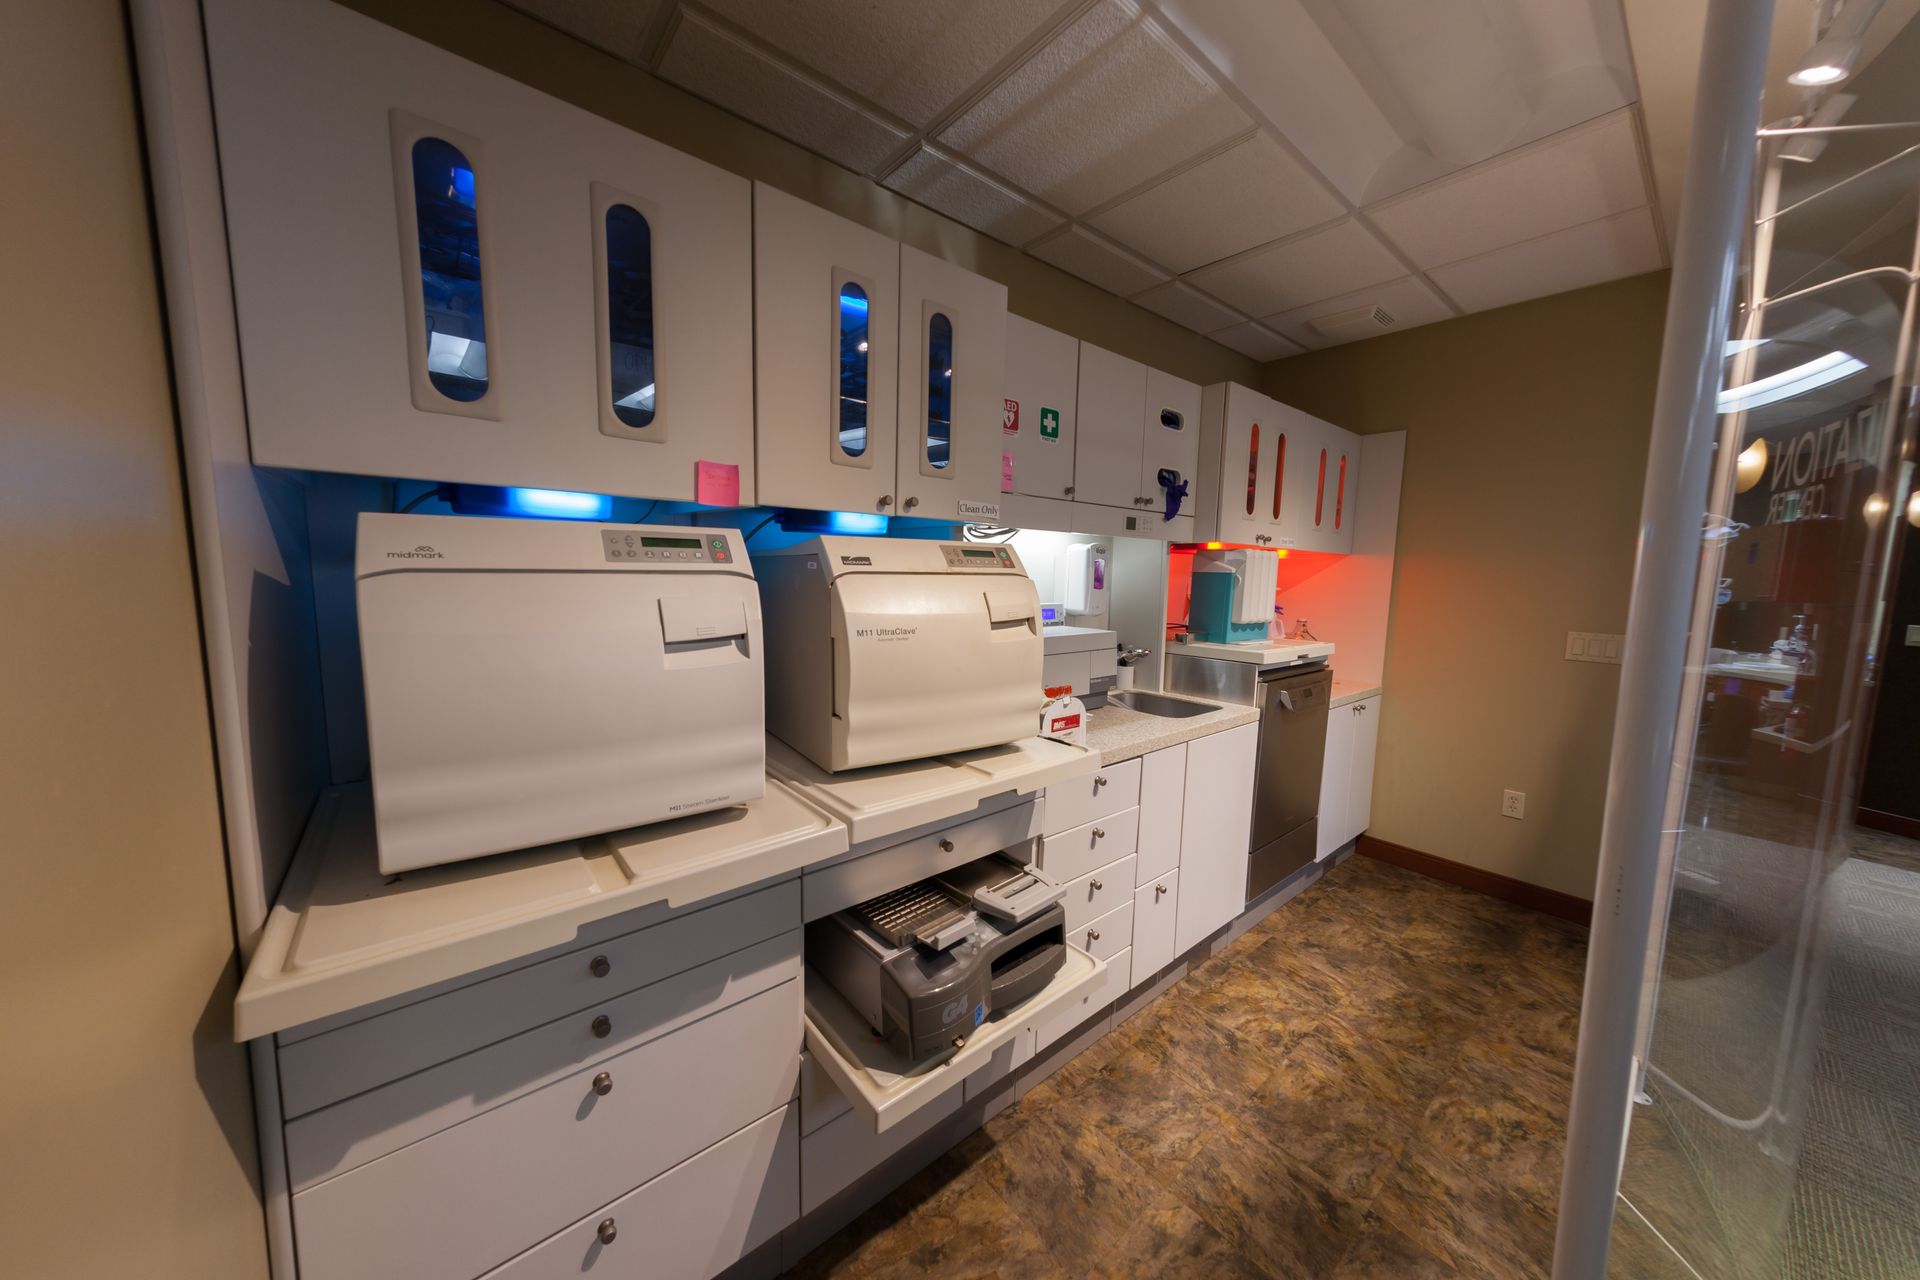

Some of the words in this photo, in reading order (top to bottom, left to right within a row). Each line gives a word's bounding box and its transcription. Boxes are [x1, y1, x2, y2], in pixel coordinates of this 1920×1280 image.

[959, 503, 980, 514] Clean
[981, 504, 999, 517] Only
[856, 629, 873, 637] M11
[875, 627, 916, 637] UltraClave
